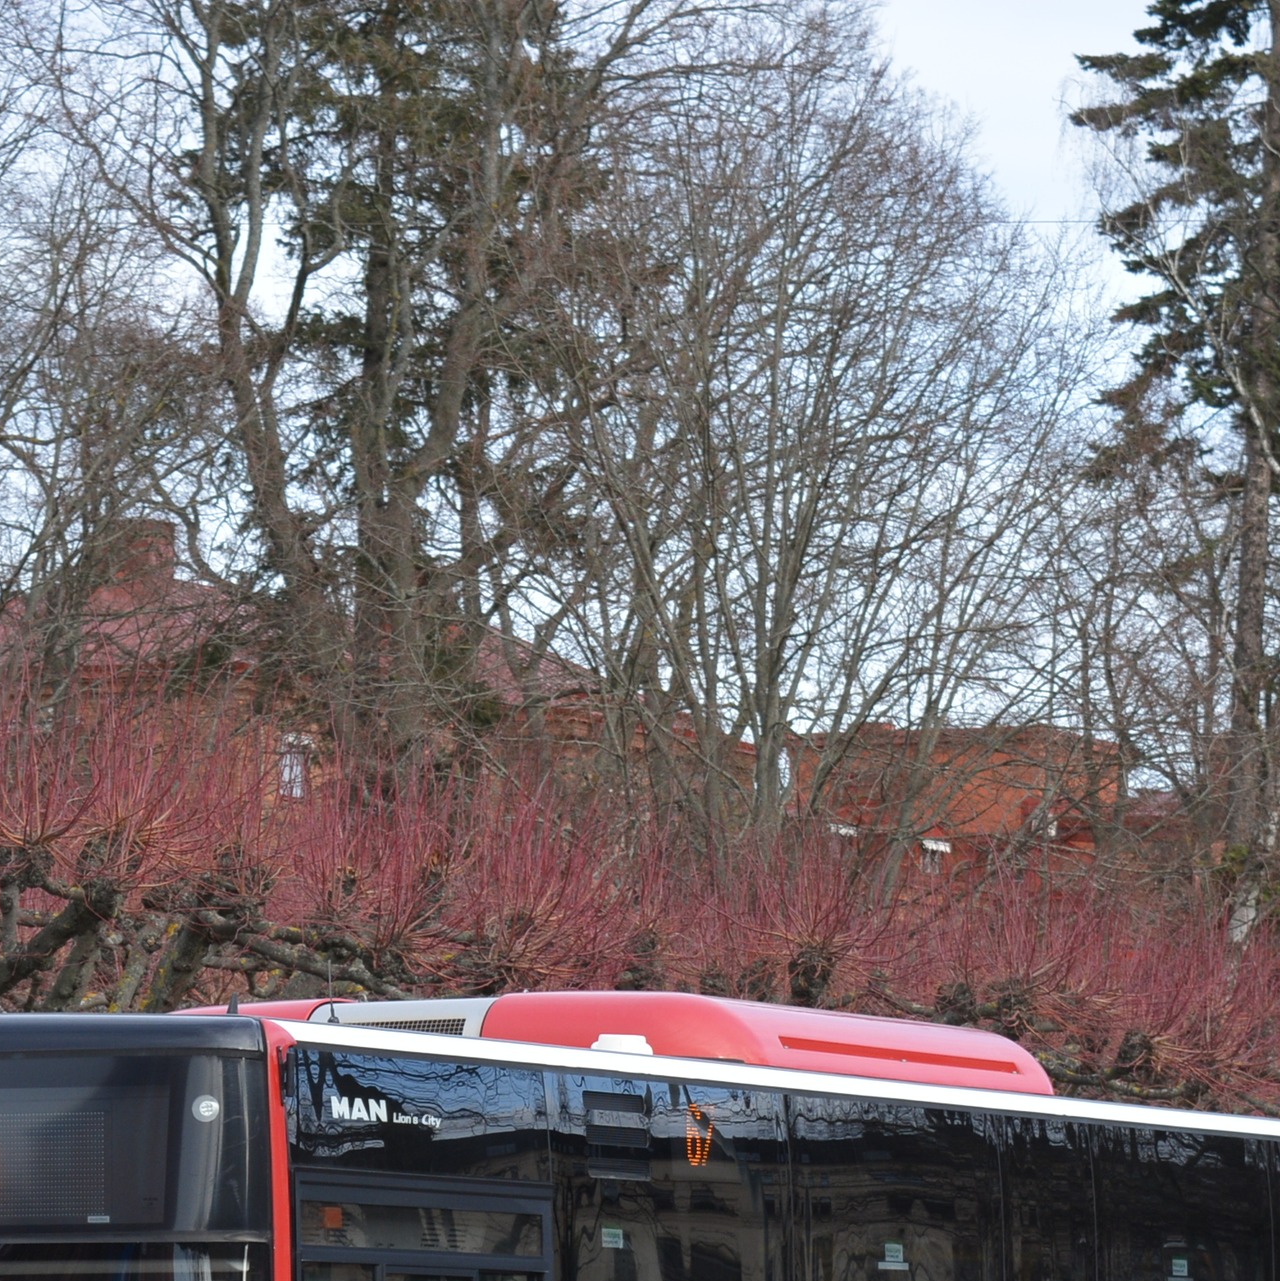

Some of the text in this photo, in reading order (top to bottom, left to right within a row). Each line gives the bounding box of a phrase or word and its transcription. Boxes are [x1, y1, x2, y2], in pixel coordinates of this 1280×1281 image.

[330, 1096, 442, 1129] MAN Lion's City
